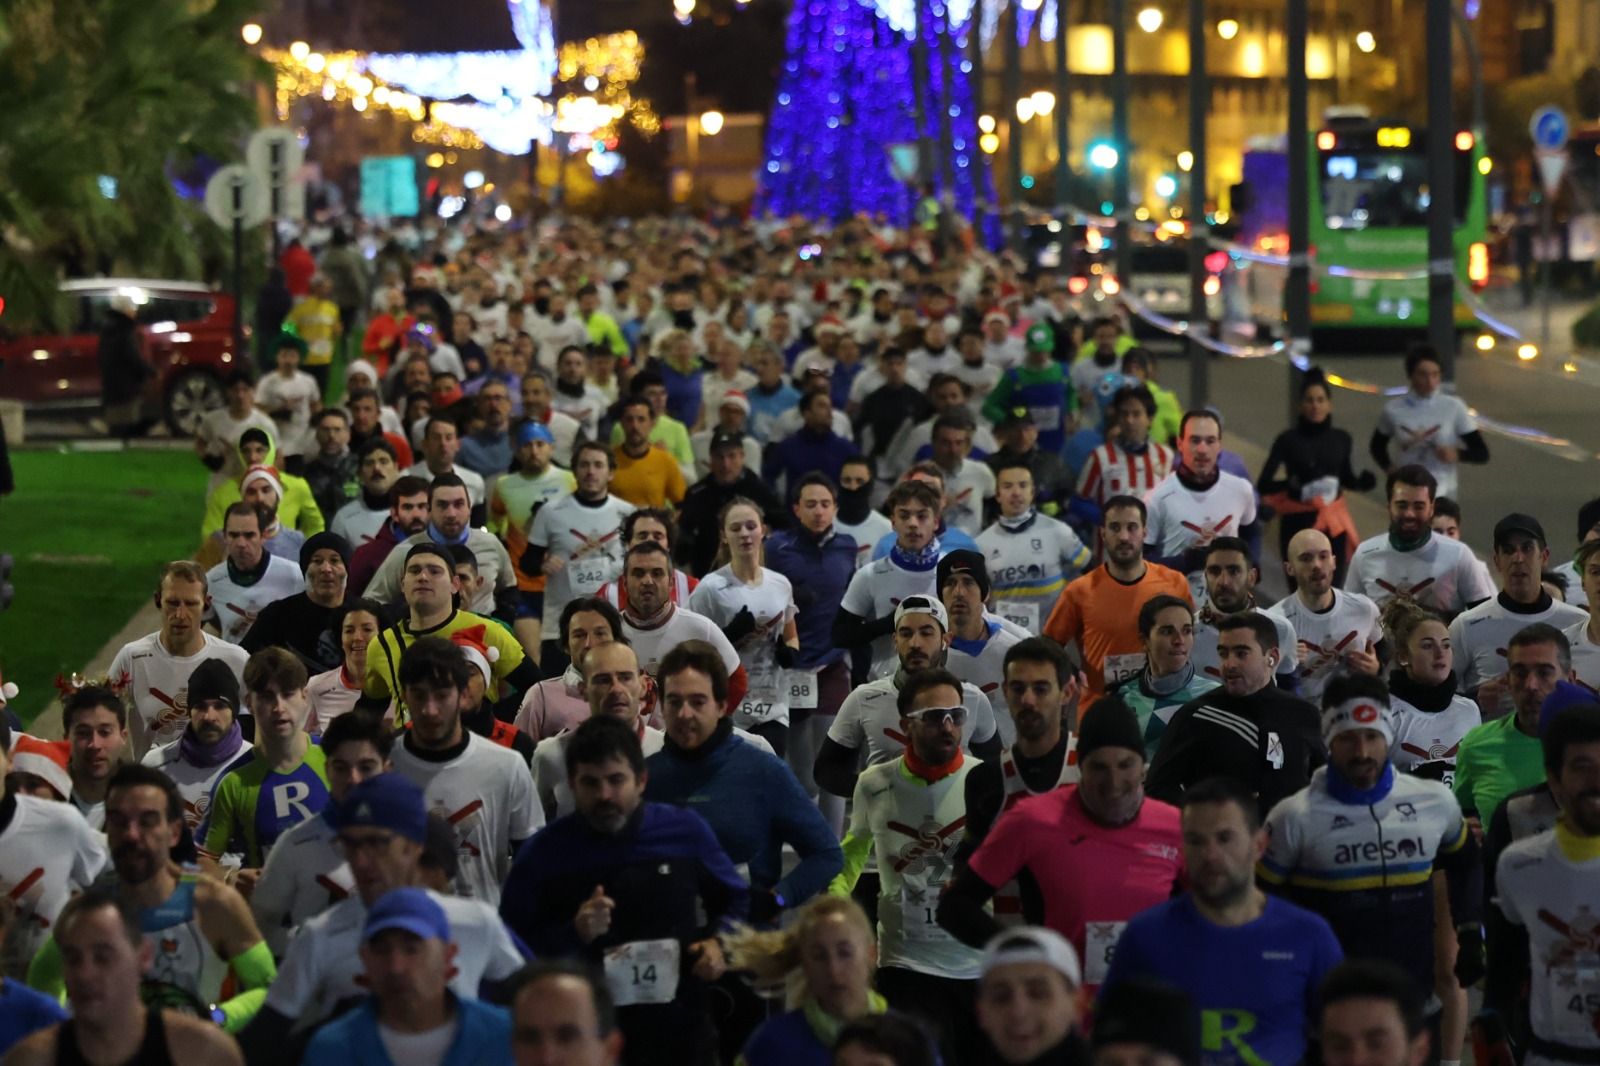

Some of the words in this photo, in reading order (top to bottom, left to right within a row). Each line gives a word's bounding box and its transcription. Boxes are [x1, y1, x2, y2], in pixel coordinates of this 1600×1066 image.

[577, 570, 604, 584] 242
[742, 702, 773, 716] 647
[273, 781, 313, 821] R
[1334, 836, 1427, 863] aresol
[631, 964, 657, 984] 14
[1201, 1009, 1274, 1066] R
